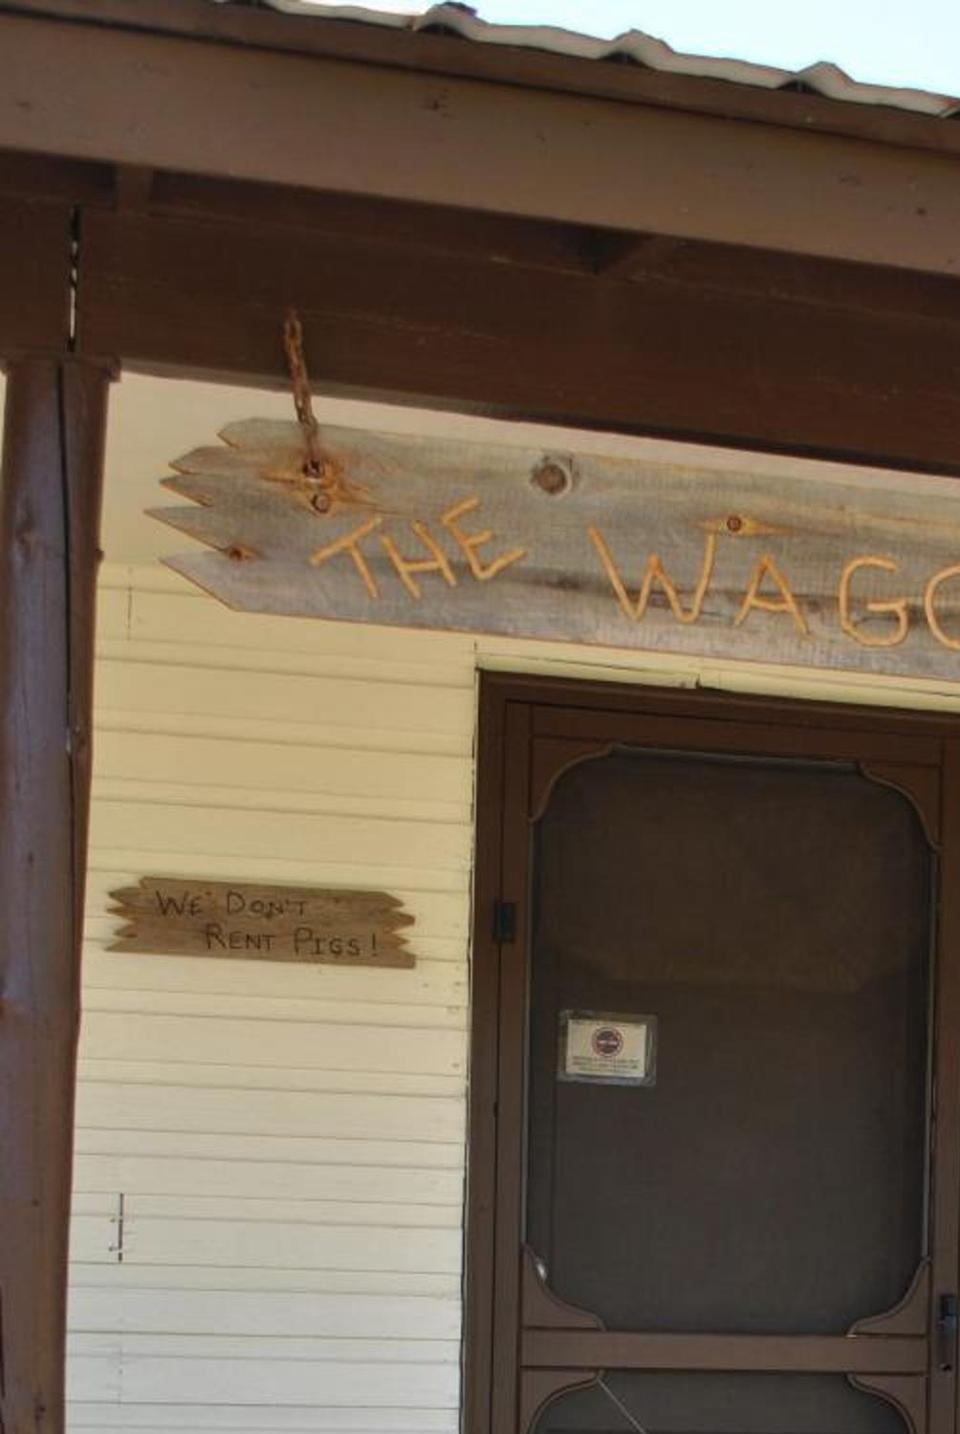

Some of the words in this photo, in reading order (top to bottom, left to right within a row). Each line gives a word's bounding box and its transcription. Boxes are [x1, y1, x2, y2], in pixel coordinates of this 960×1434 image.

[309, 498, 528, 600] THE
[155, 890, 204, 917] WE
[226, 892, 308, 918] DON'T
[205, 922, 278, 951] RENT
